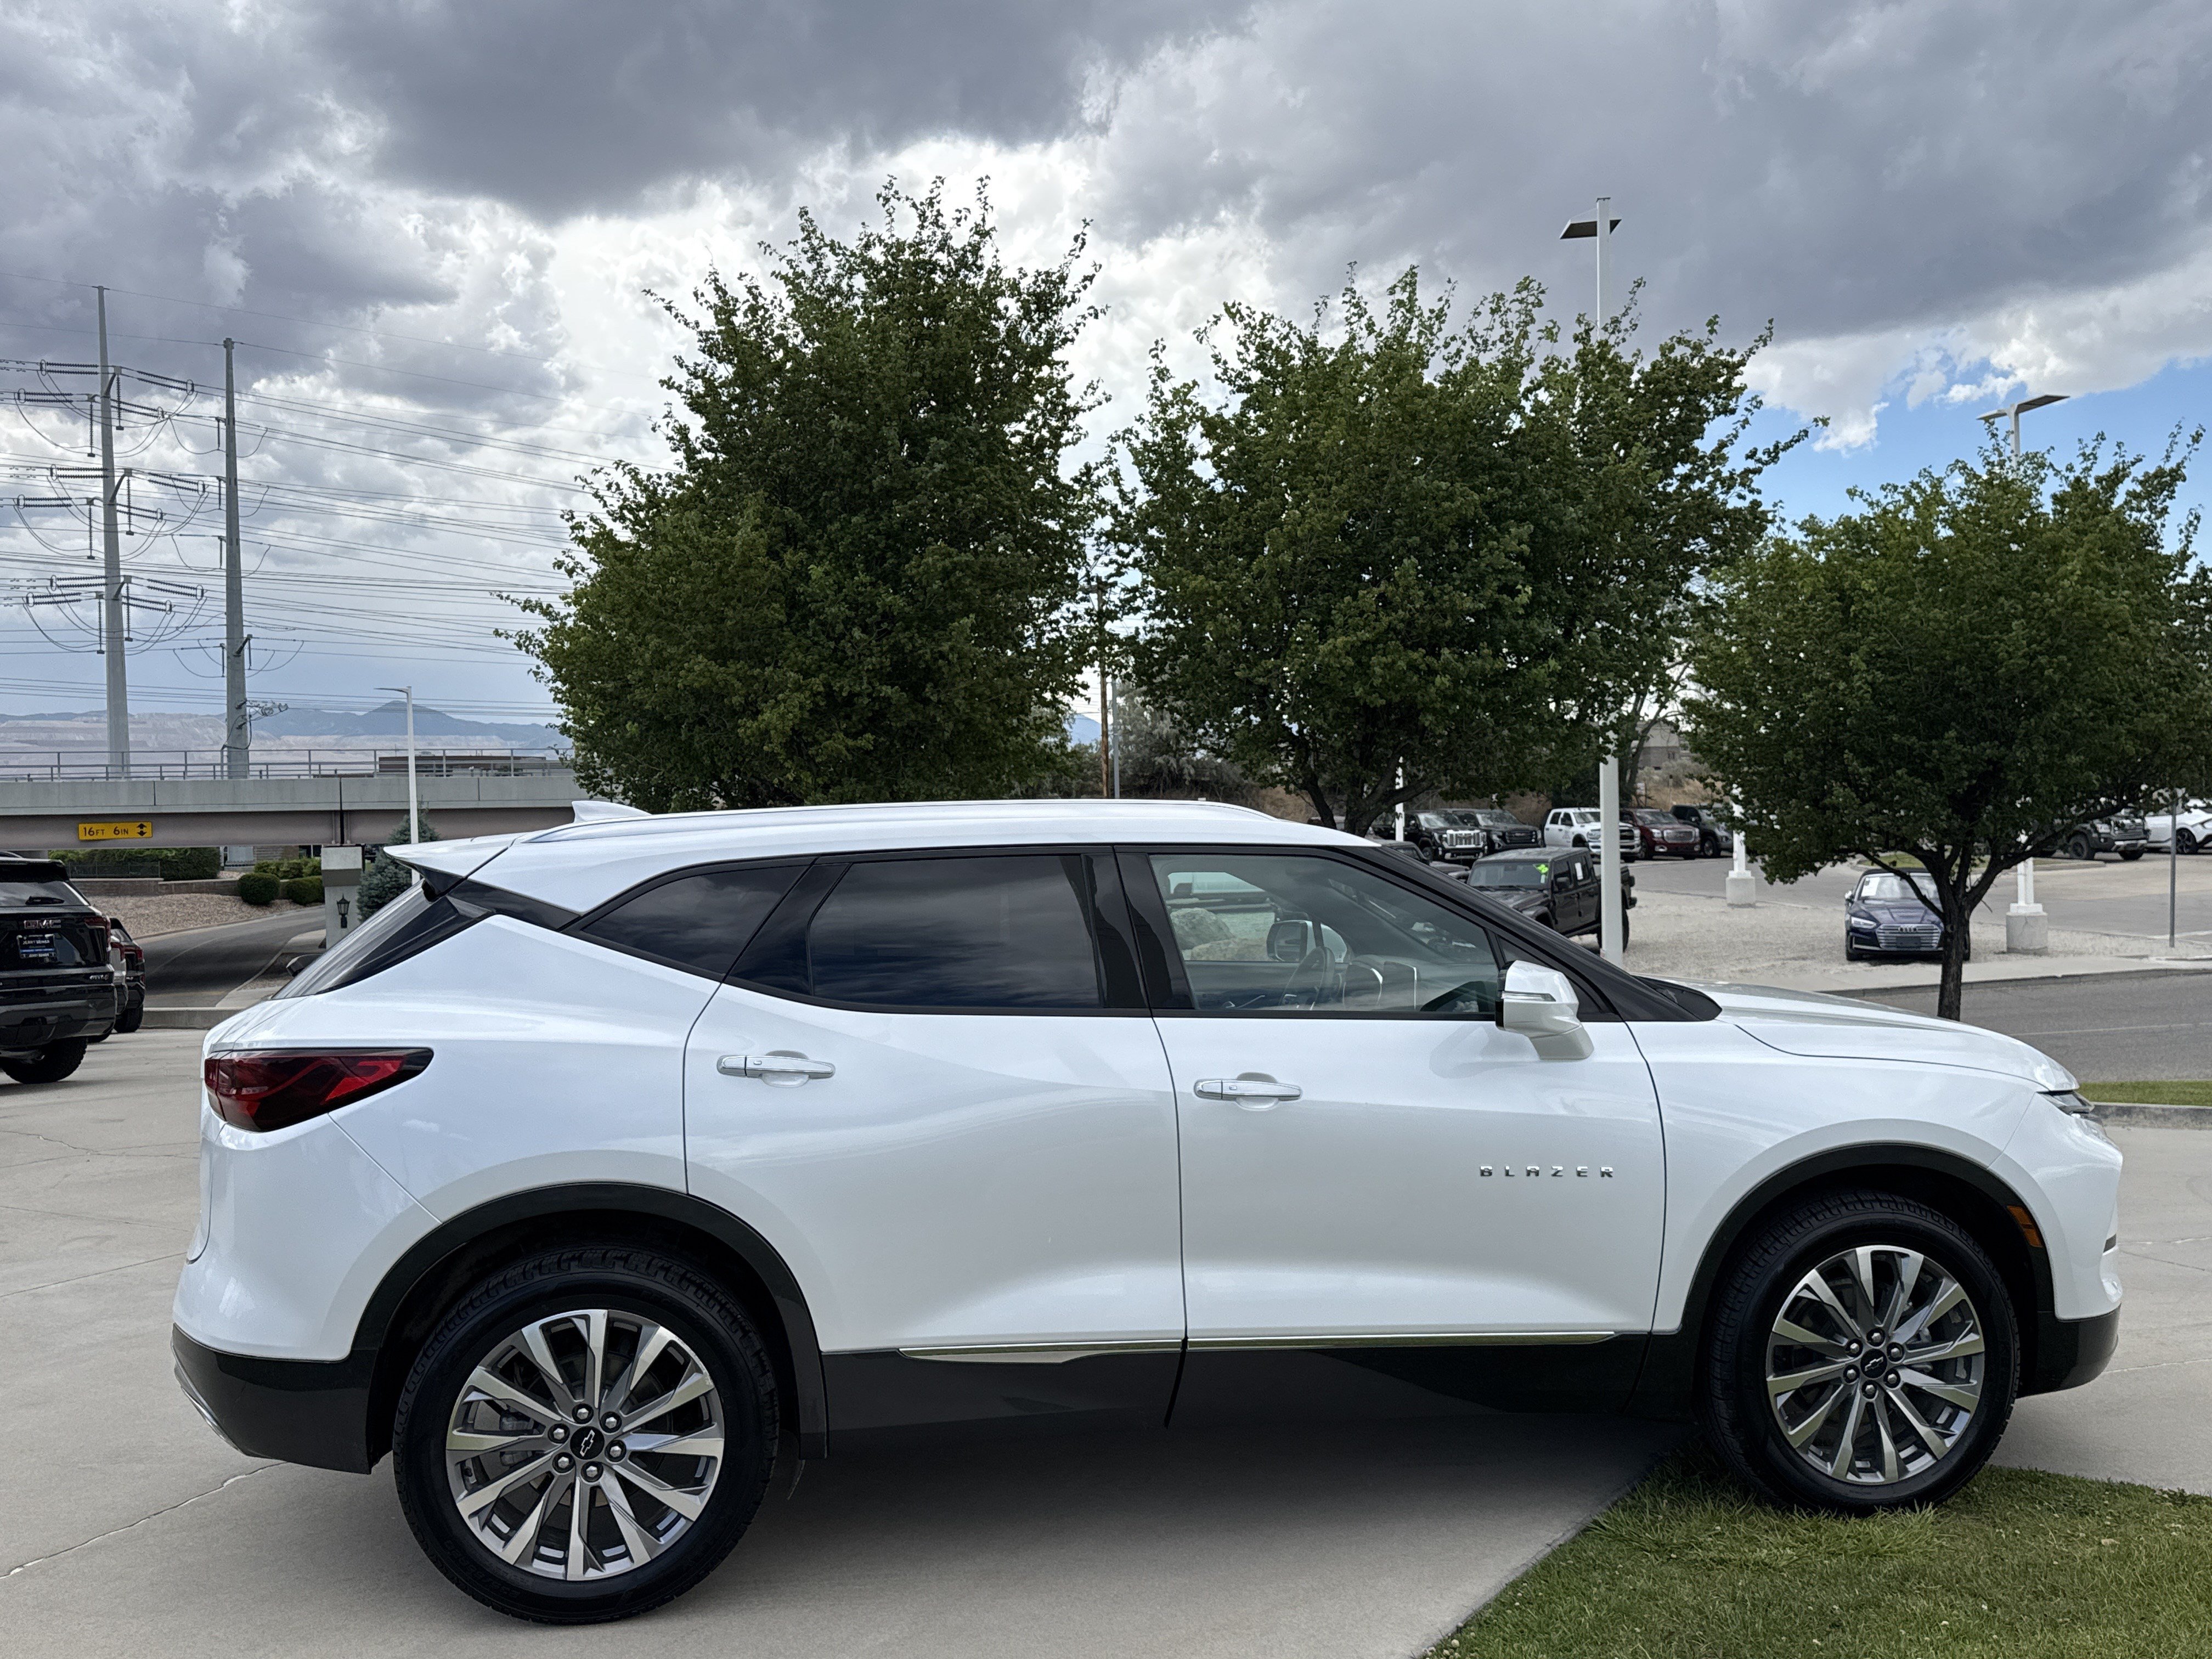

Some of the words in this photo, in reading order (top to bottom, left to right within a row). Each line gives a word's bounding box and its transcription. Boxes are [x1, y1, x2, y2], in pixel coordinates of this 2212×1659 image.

[83, 827, 105, 837] 16FT
[113, 826, 129, 836] 6IN
[23, 919, 61, 929] GMC
[1480, 1166, 1613, 1177] BLAZER
